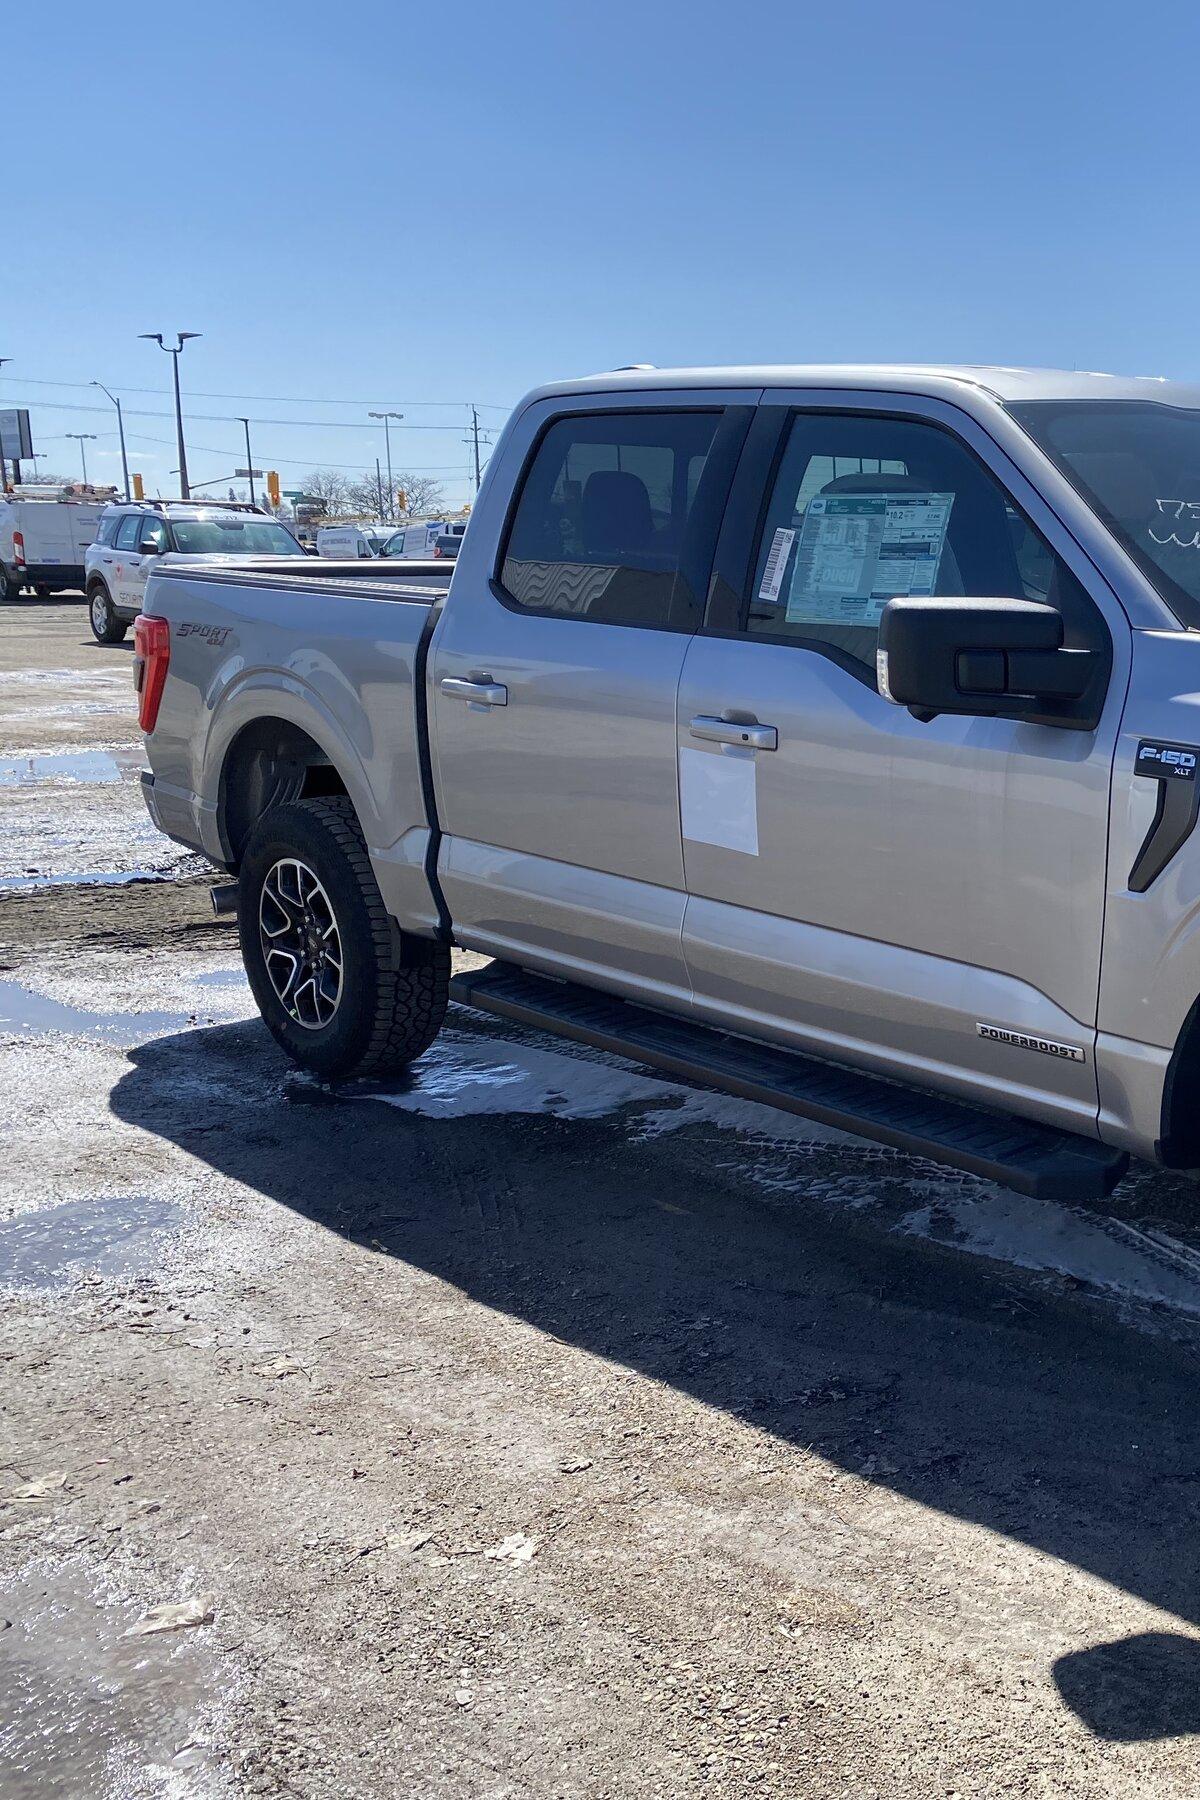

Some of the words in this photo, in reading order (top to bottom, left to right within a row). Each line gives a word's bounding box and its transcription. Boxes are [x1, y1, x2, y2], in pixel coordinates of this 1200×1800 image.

[176, 623, 233, 640] SPORT
[1139, 747, 1196, 767] F-150
[1174, 767, 1191, 776] XLT
[980, 1026, 1077, 1059] POWERBOOST
